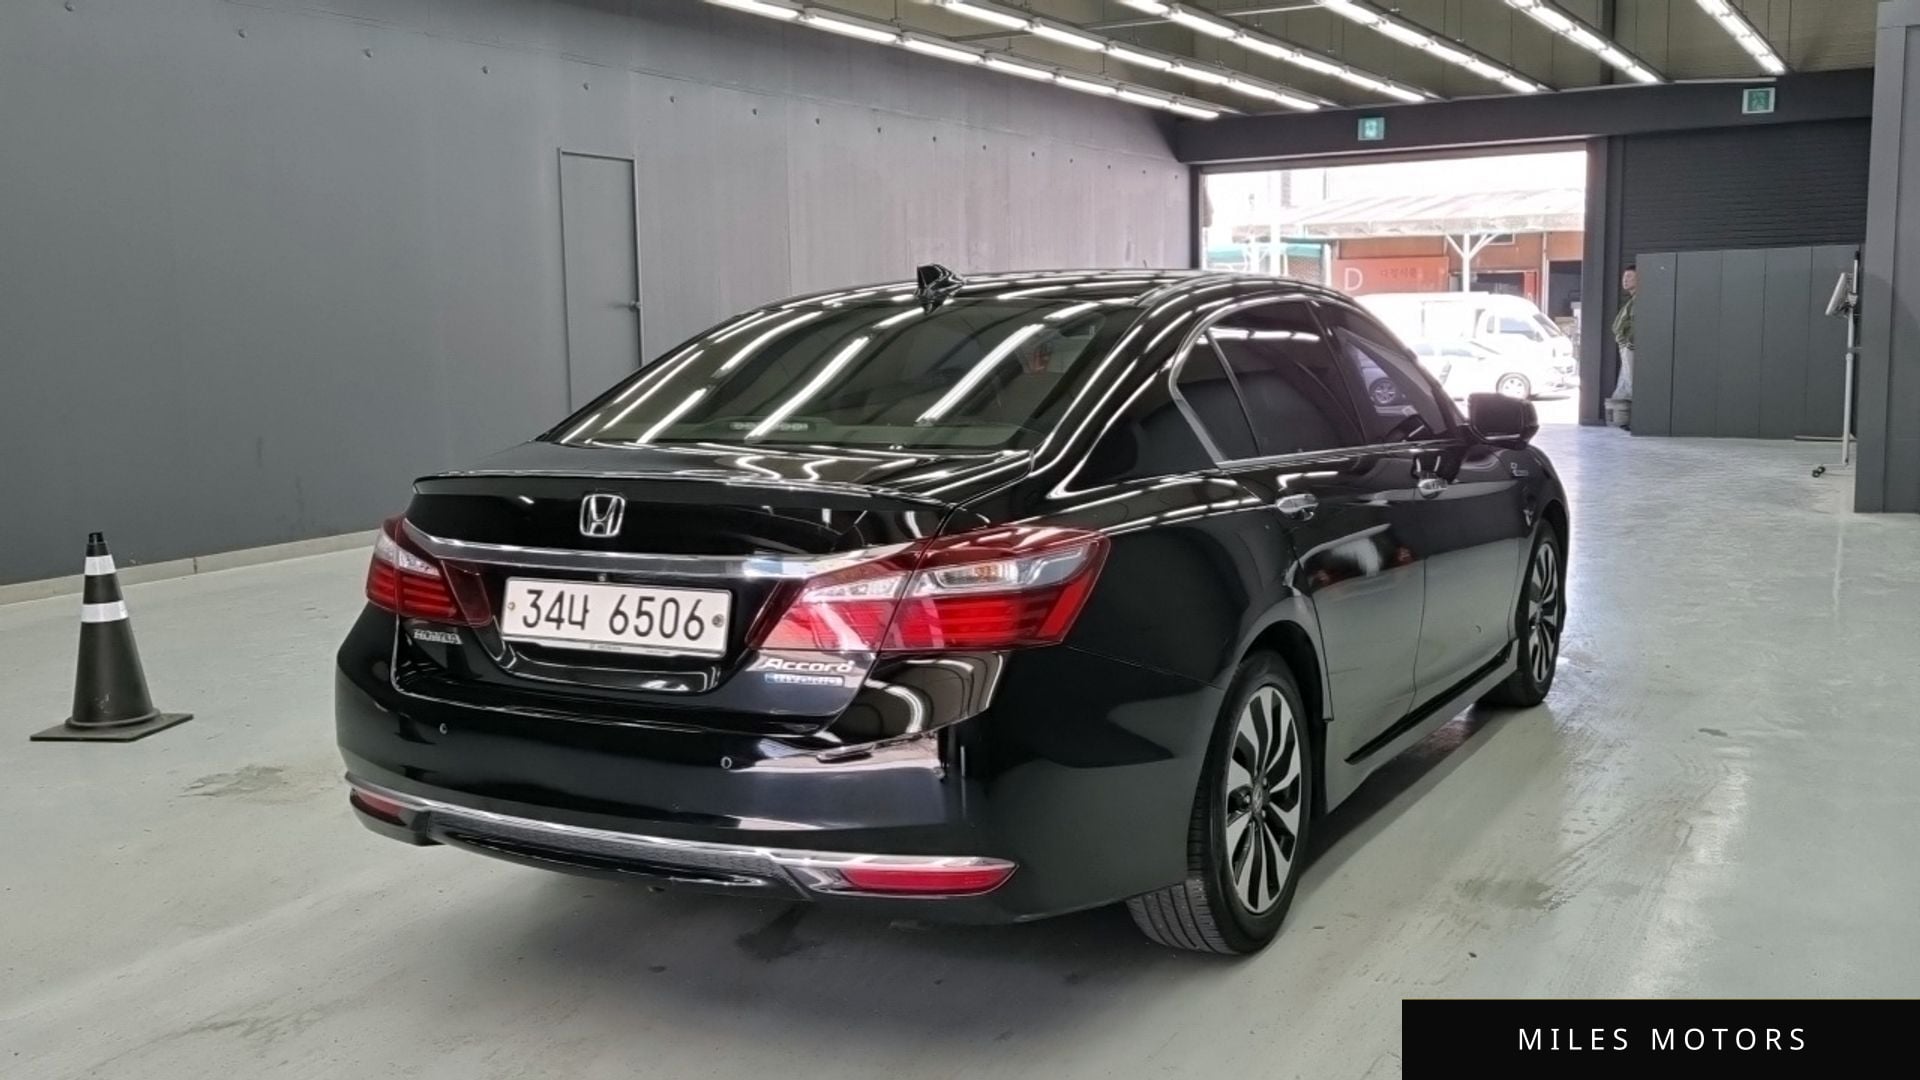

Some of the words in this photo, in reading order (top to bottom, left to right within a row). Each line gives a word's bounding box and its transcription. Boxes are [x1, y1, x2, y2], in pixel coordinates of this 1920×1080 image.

[1344, 267, 1363, 292] D
[522, 589, 590, 630] 34나
[609, 594, 705, 641] 6506
[759, 658, 855, 673] Accord
